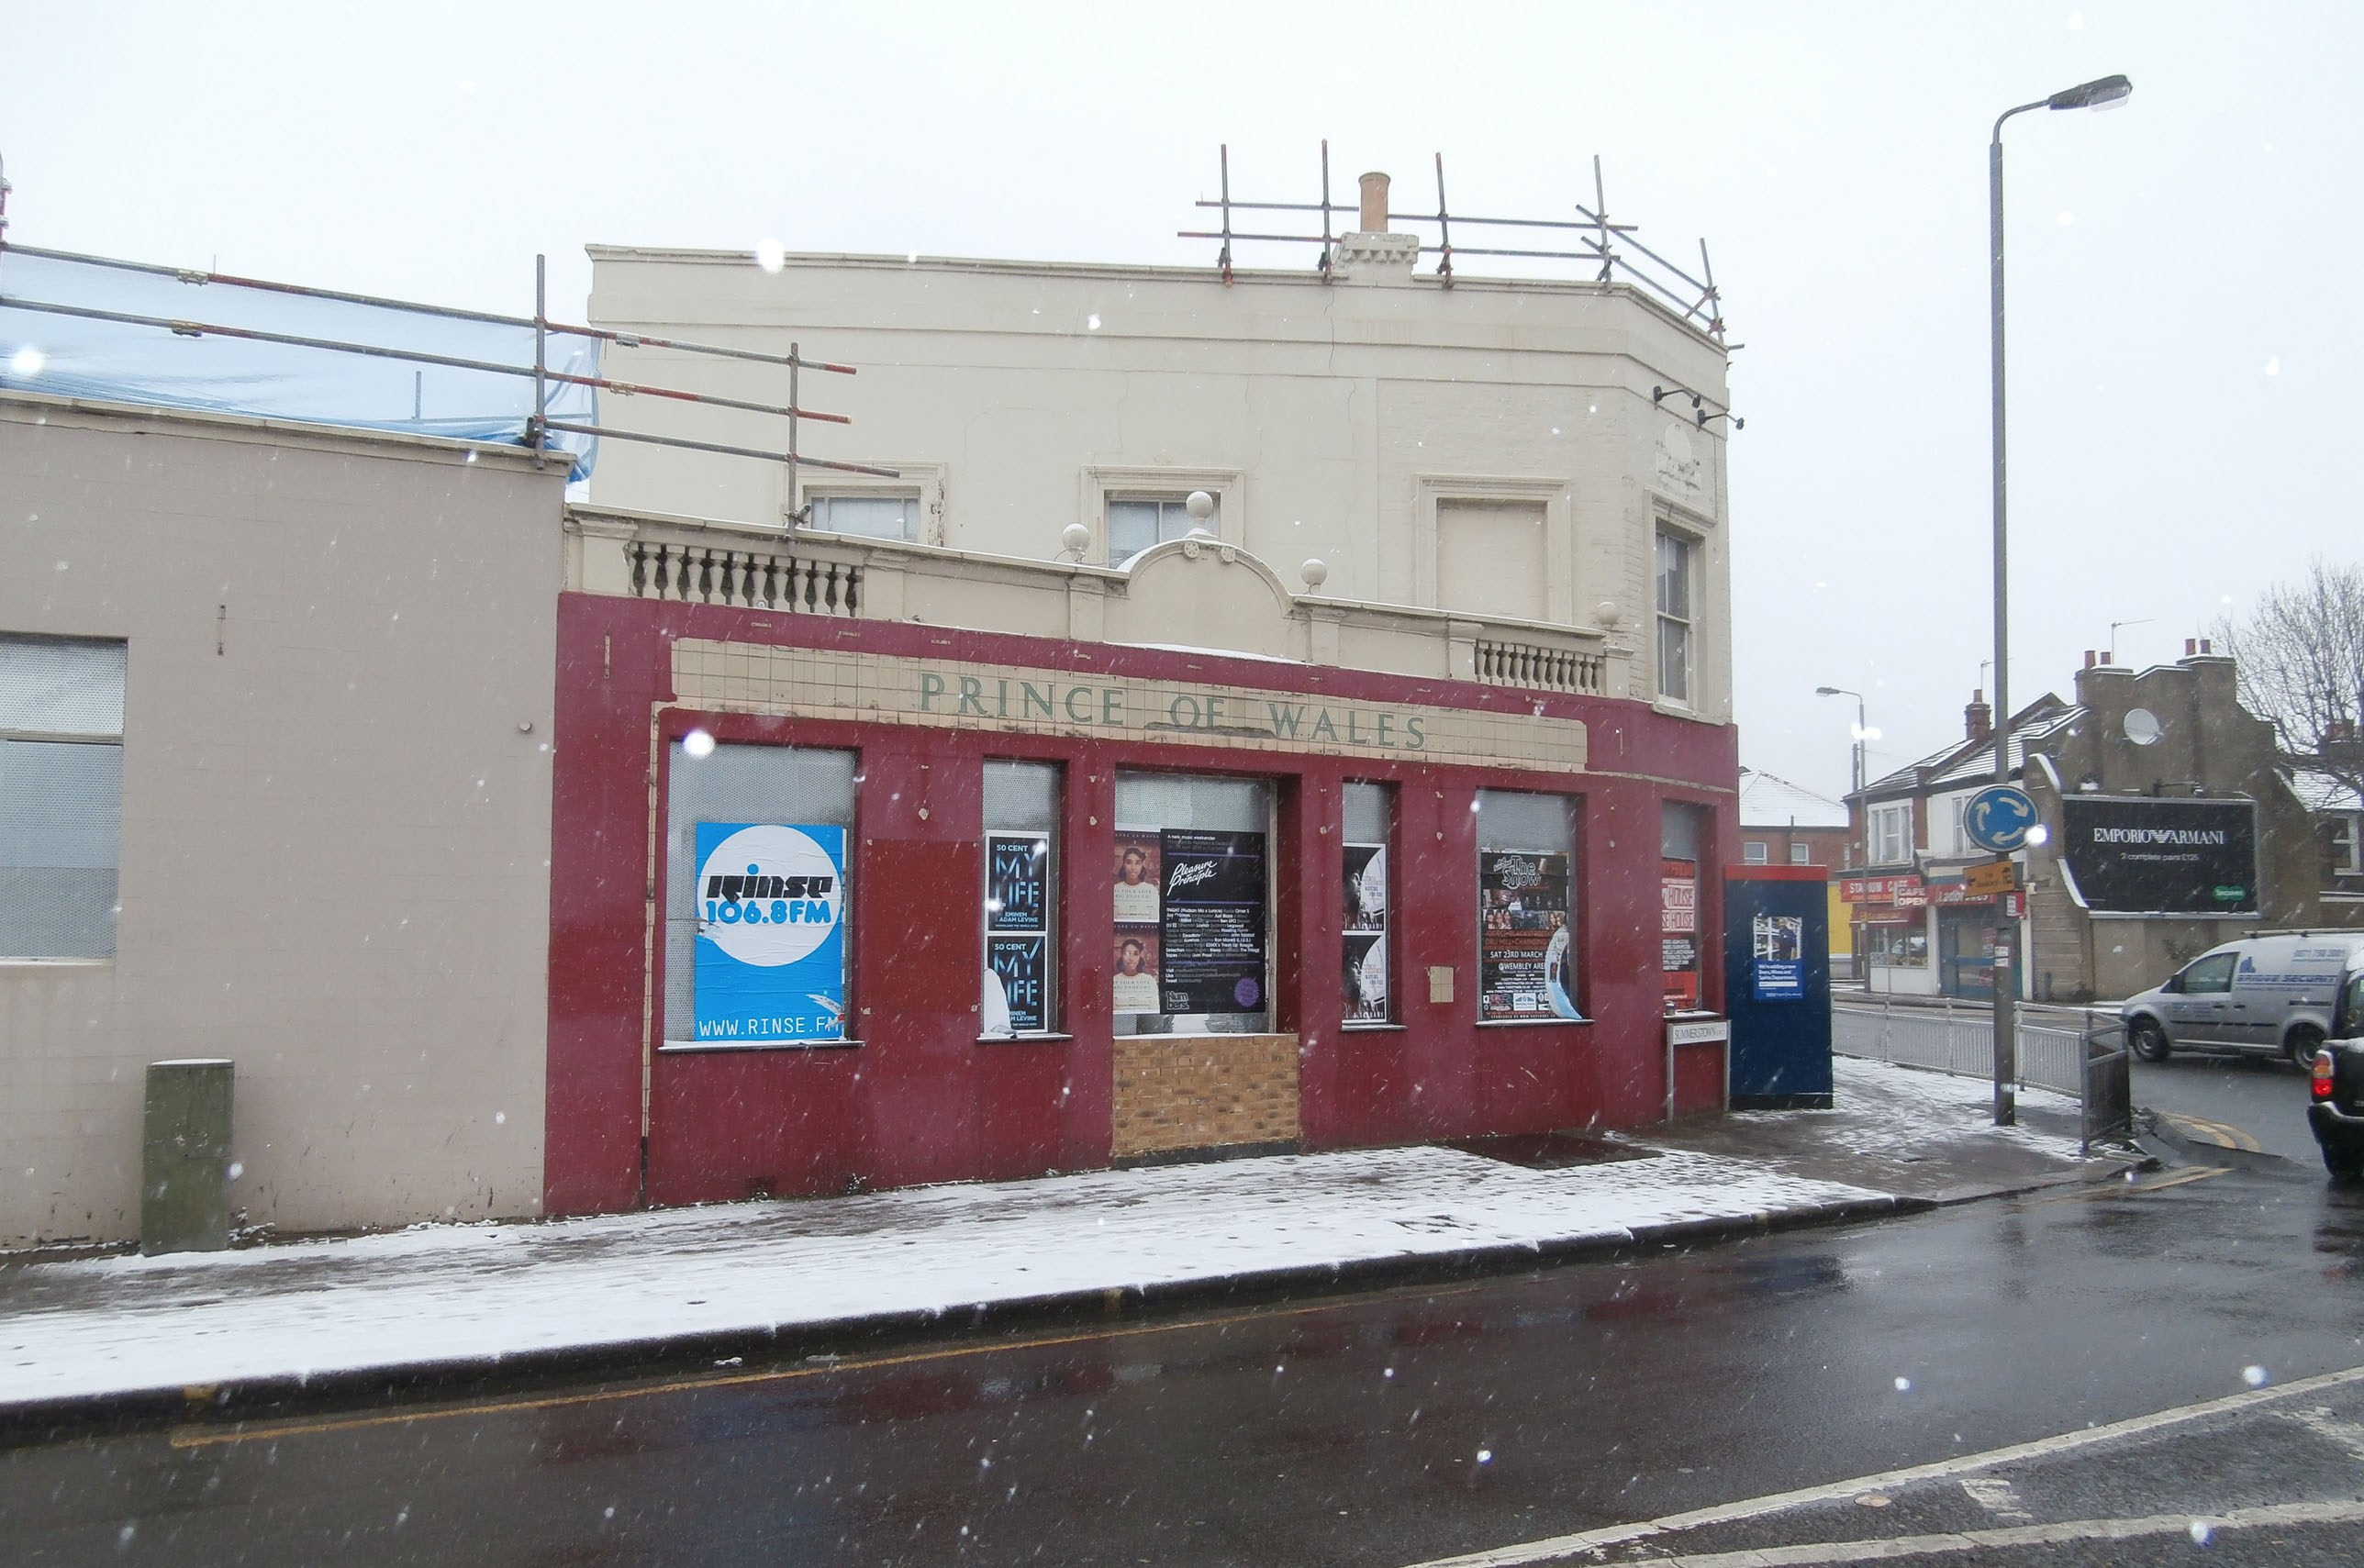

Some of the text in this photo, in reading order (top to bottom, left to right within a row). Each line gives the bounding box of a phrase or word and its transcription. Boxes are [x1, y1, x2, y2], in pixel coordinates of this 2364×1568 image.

[920, 673, 1425, 750] PRINCE OF WALES
[2093, 828, 2224, 845] EMPORIO ARMANI
[996, 844, 1028, 852] 50 CENT
[2128, 852, 2161, 862] complete
[996, 840, 1043, 878] MY
[1511, 855, 1536, 875] The
[1166, 868, 1218, 896] Principle
[1169, 860, 1218, 885] Pleasure
[1502, 866, 1540, 890] Show
[995, 881, 1039, 908] LIFE
[1668, 887, 1694, 907] HOUSE
[1849, 881, 1882, 894] STAIUM
[1898, 887, 1926, 896] CAFE
[1898, 897, 1929, 906] OPEN
[706, 900, 831, 925] 106.8FM
[994, 938, 1042, 978] MY
[1490, 951, 1501, 959] SAT
[1503, 951, 1520, 959] 23RD
[1499, 962, 1532, 971] @WEMBLEY
[1007, 979, 1038, 1006] IFE
